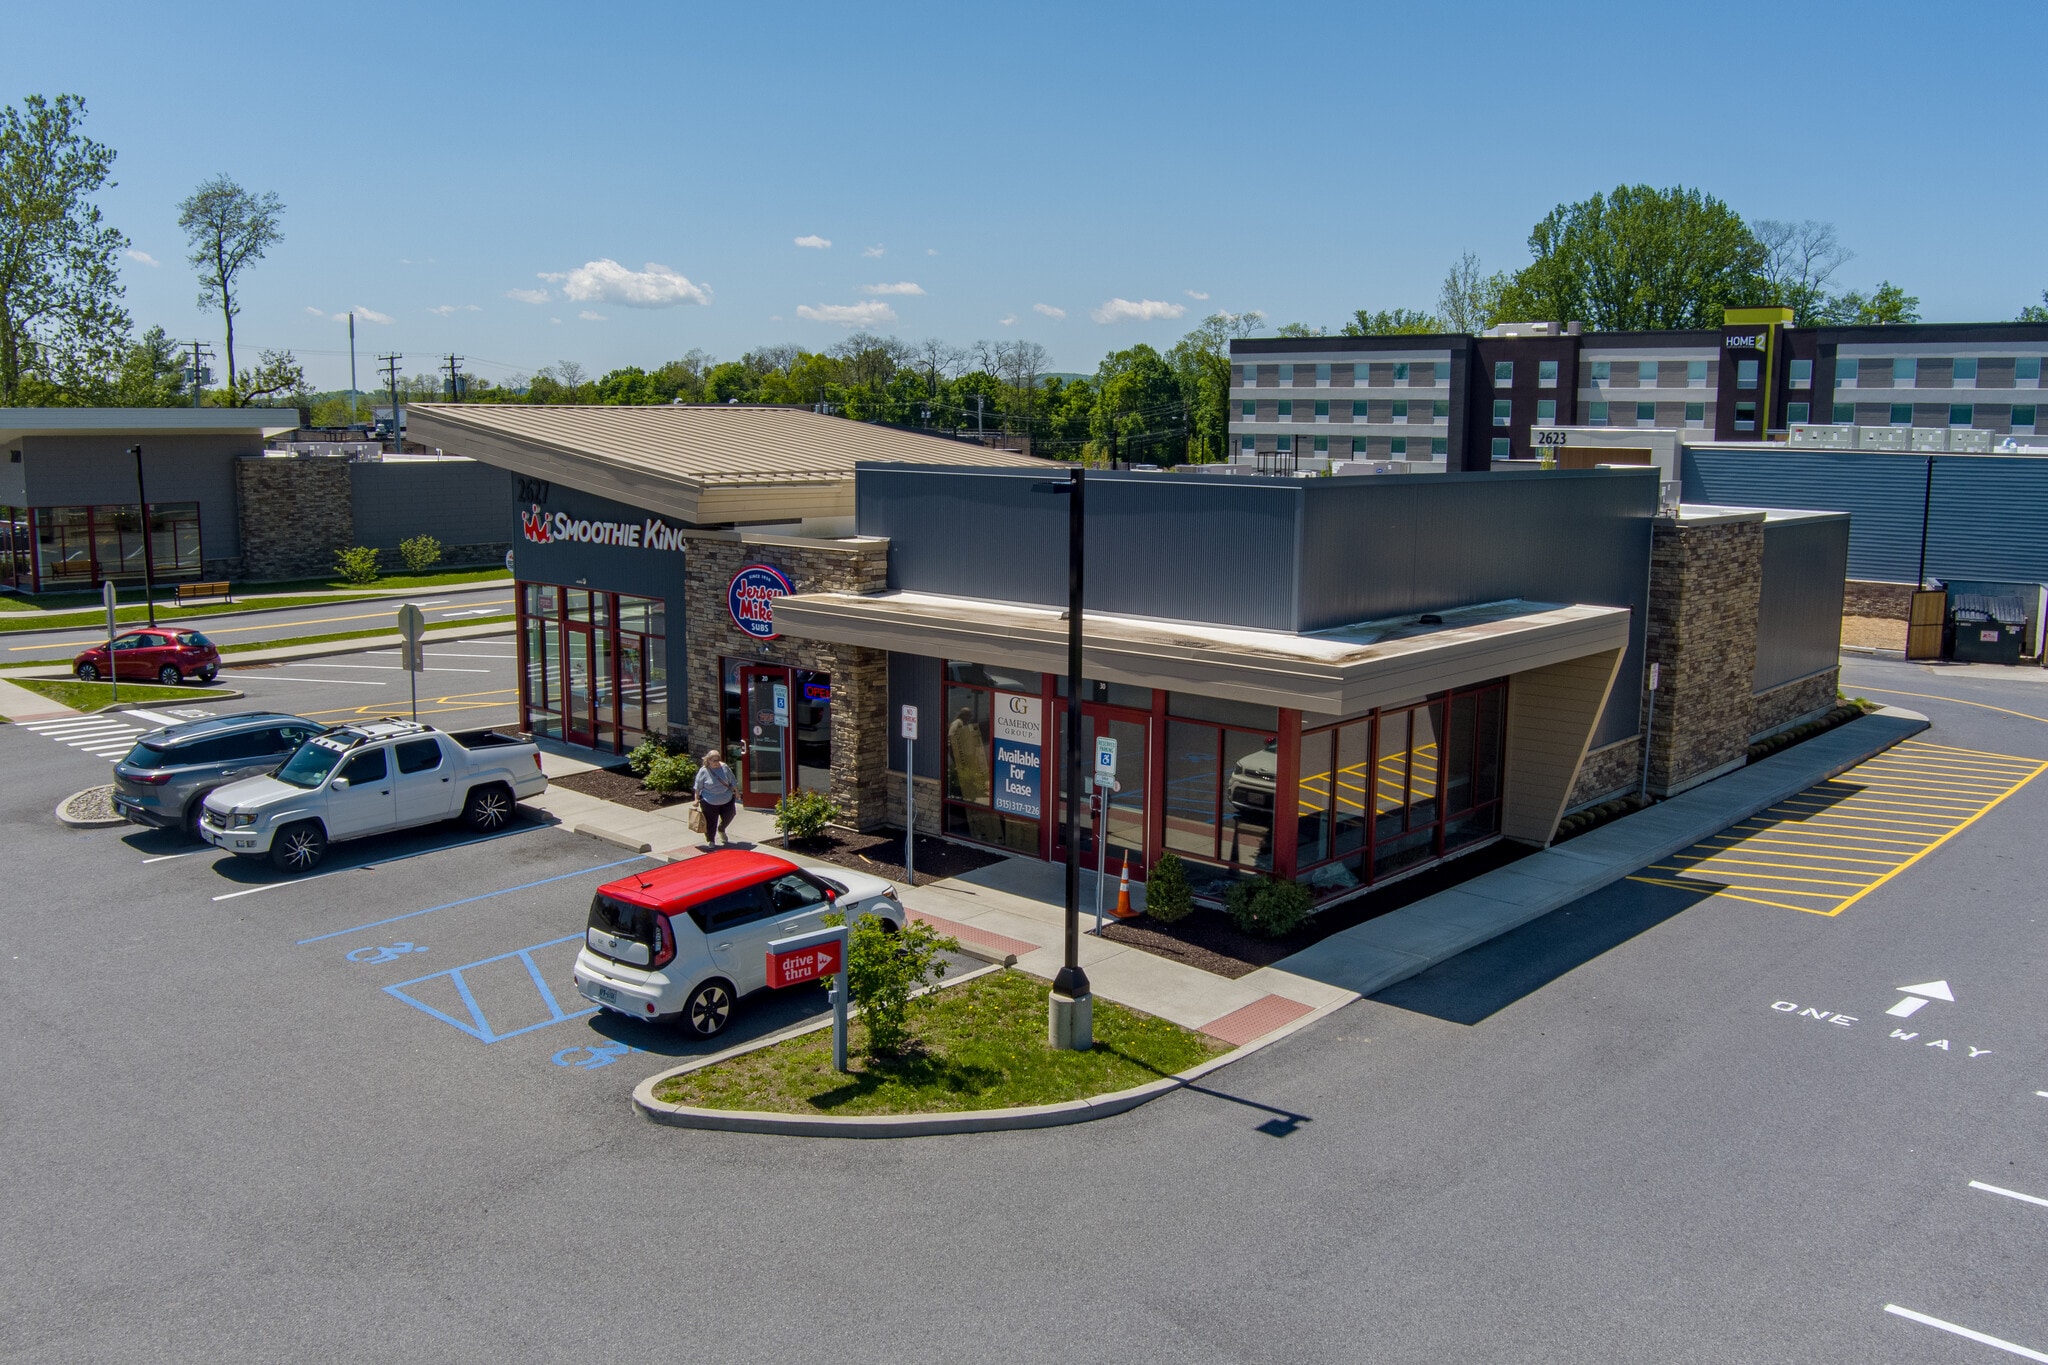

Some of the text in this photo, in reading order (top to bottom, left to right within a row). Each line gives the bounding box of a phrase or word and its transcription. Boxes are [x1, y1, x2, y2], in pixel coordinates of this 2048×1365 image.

[1538, 431, 1567, 445] 2623
[517, 478, 550, 505] 2627
[751, 623, 769, 632] SUBS
[997, 717, 1040, 731] CAMERON
[1005, 728, 1033, 738] GROUP
[998, 747, 1040, 768] Available
[1010, 764, 1025, 780] For
[1005, 778, 1032, 797] Lease
[783, 956, 813, 970] drive
[785, 967, 811, 980] thru
[1770, 1001, 1859, 1026] ONE
[1889, 1028, 1992, 1058] WAY
